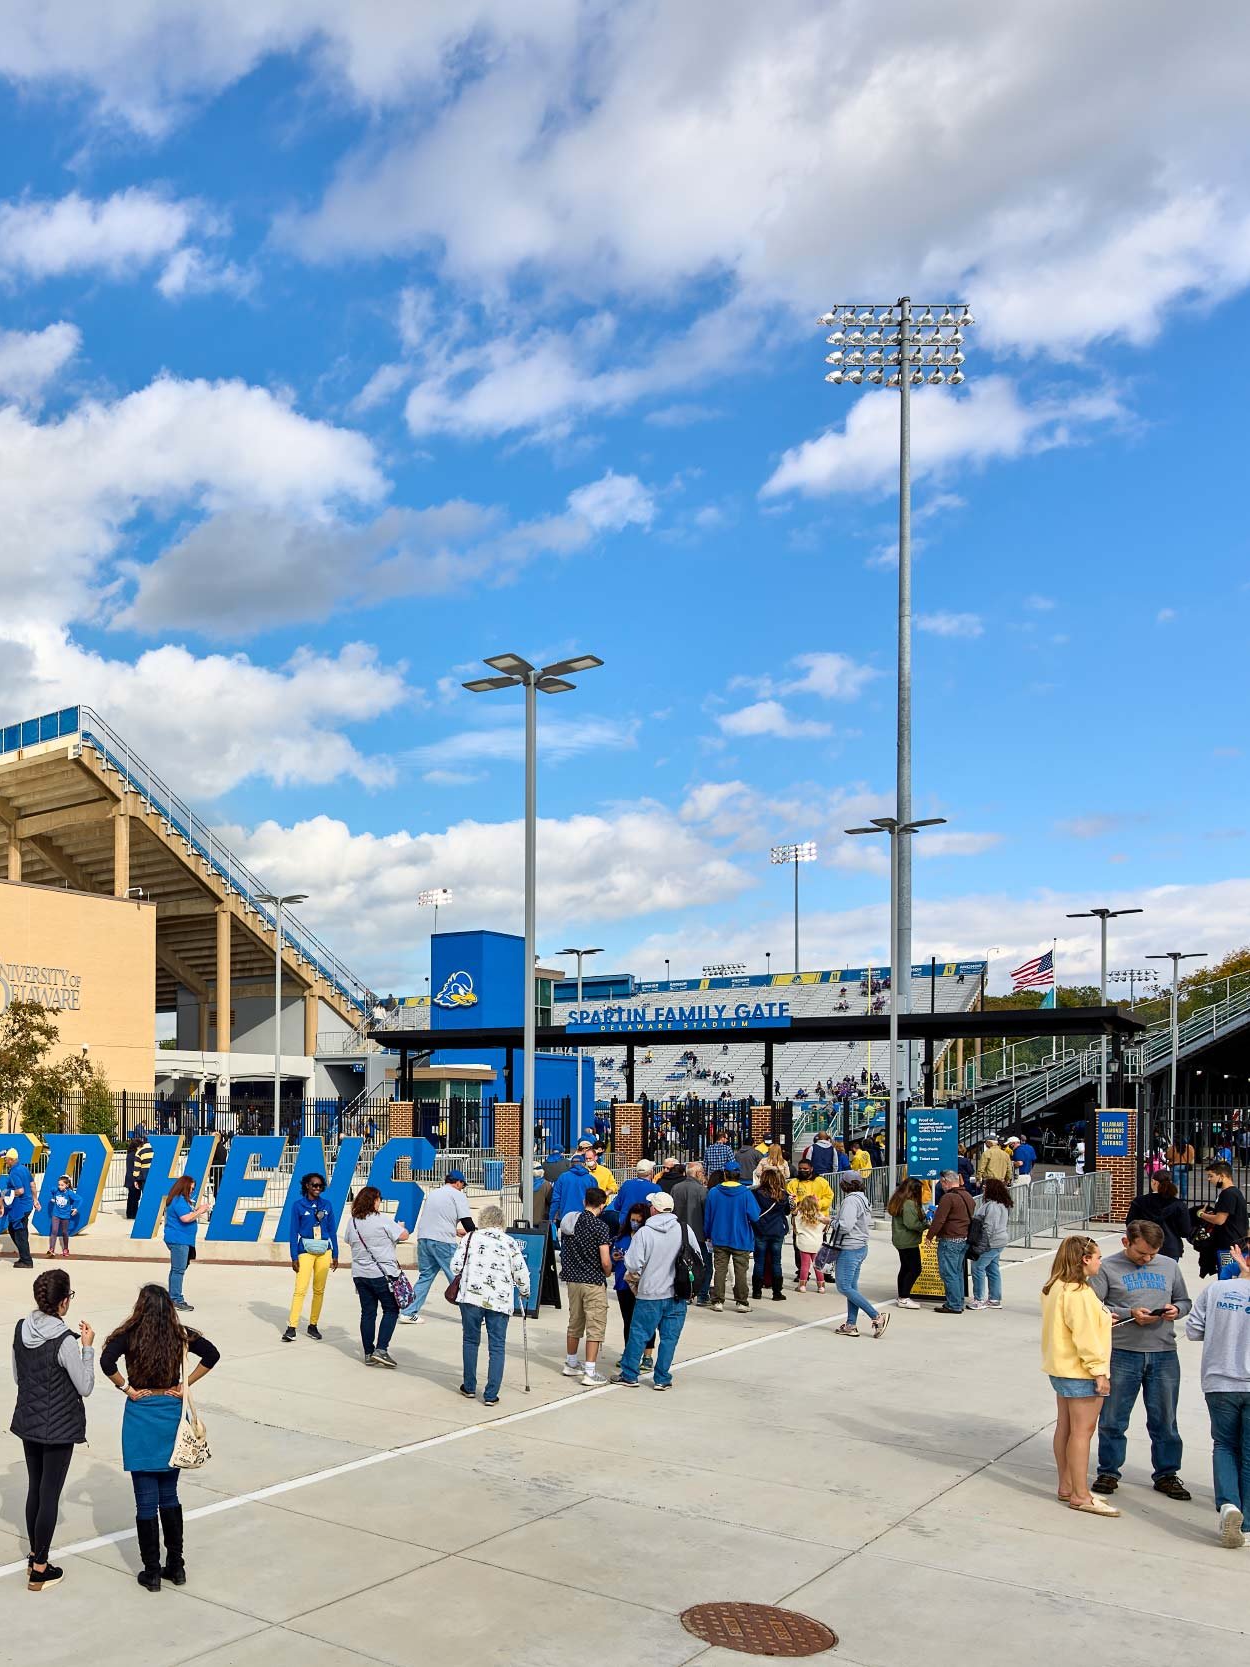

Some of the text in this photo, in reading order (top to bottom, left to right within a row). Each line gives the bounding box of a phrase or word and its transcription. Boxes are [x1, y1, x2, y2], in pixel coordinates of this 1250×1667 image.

[69, 975, 82, 988] OF
[567, 1002, 790, 1026] SPARTIN FAMILY GATE
[600, 1020, 749, 1031] DELAWARE STADIUM
[131, 1134, 437, 1242] HENS
[1122, 1272, 1166, 1284] DELAWARE
[1126, 1280, 1146, 1292] BLUE
